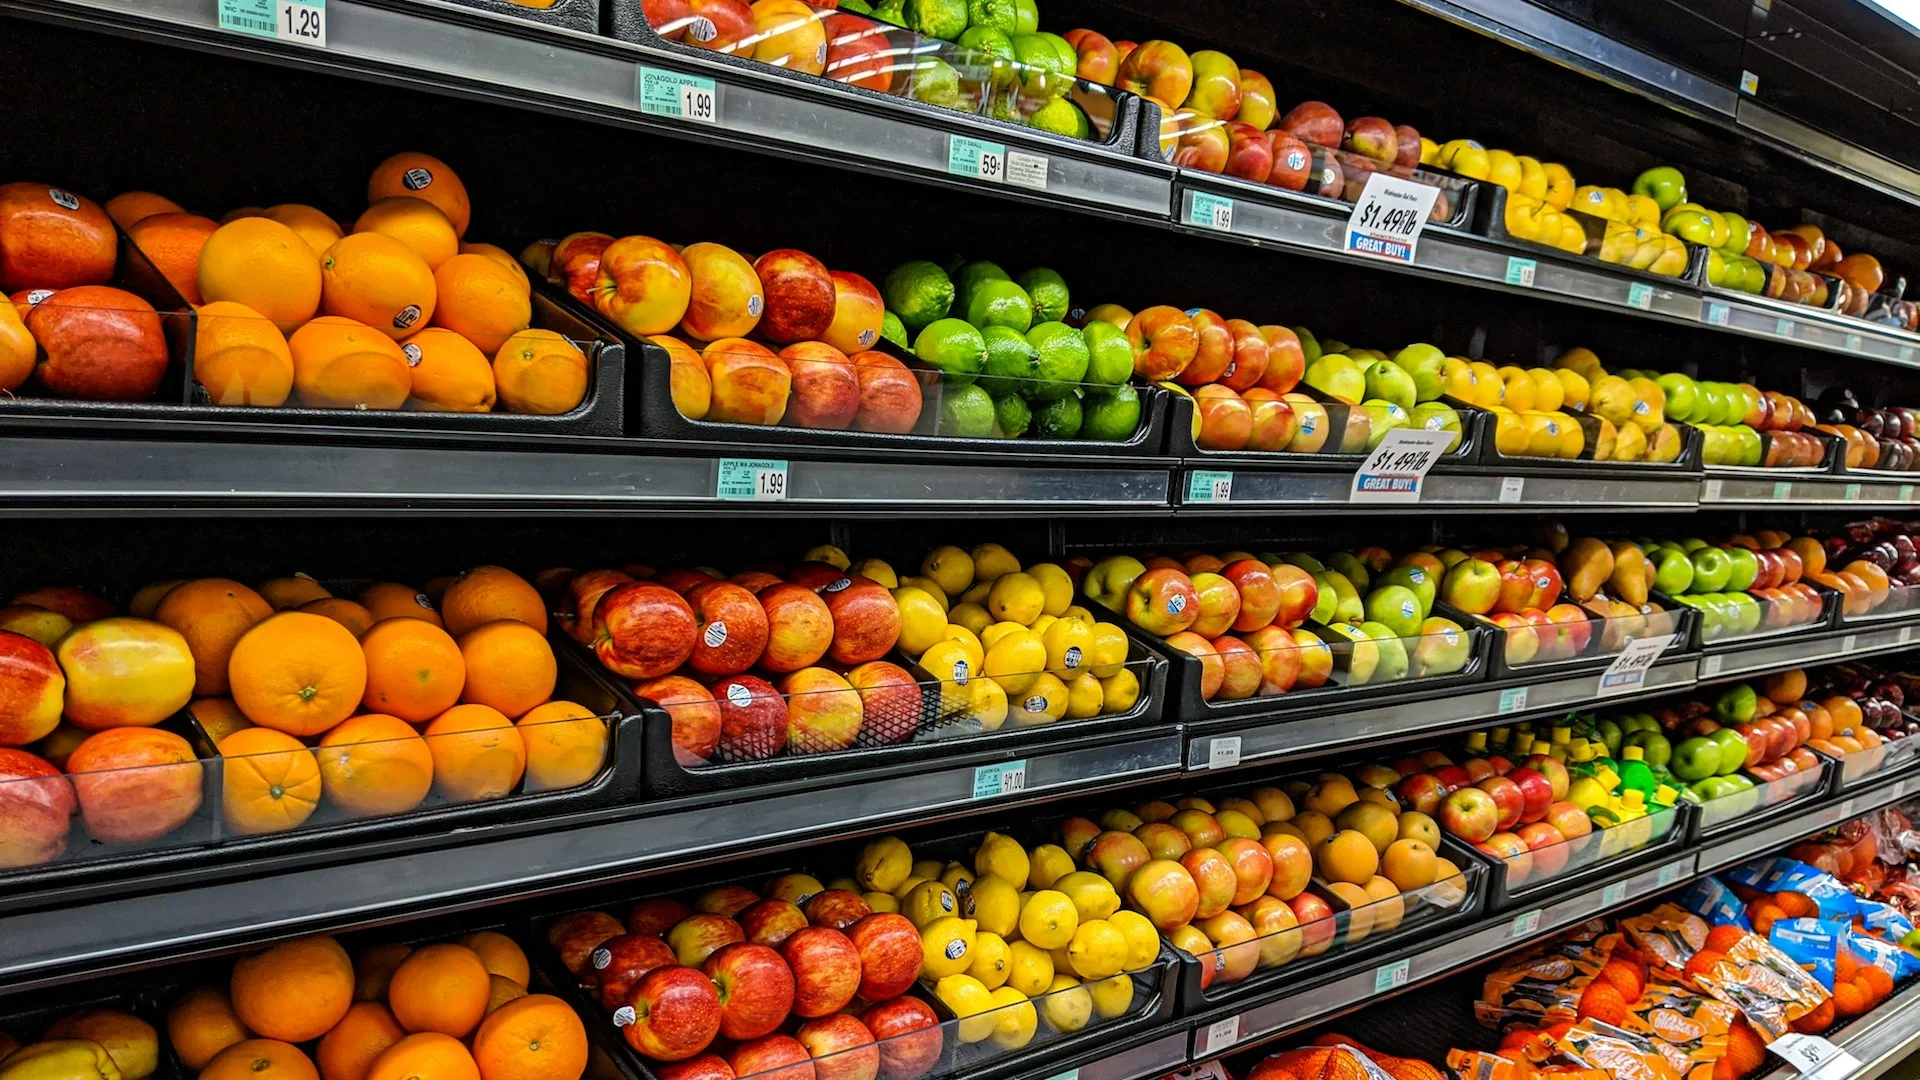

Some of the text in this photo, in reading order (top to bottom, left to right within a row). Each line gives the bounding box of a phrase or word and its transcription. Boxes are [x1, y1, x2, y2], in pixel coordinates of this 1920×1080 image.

[285, 6, 320, 39] 1.29
[644, 73, 698, 88] JONAGOLD APPLE
[686, 91, 711, 118] 1.99
[1216, 208, 1230, 228] 1.99
[1360, 200, 1403, 233] $1.49
[1356, 237, 1384, 254] GREAT
[1385, 241, 1406, 258] BUY!
[1371, 449, 1415, 471] $1.49
[761, 472, 783, 494] 1.99
[1216, 481, 1229, 498] 1.99
[1363, 478, 1413, 490] GREAT BUY!
